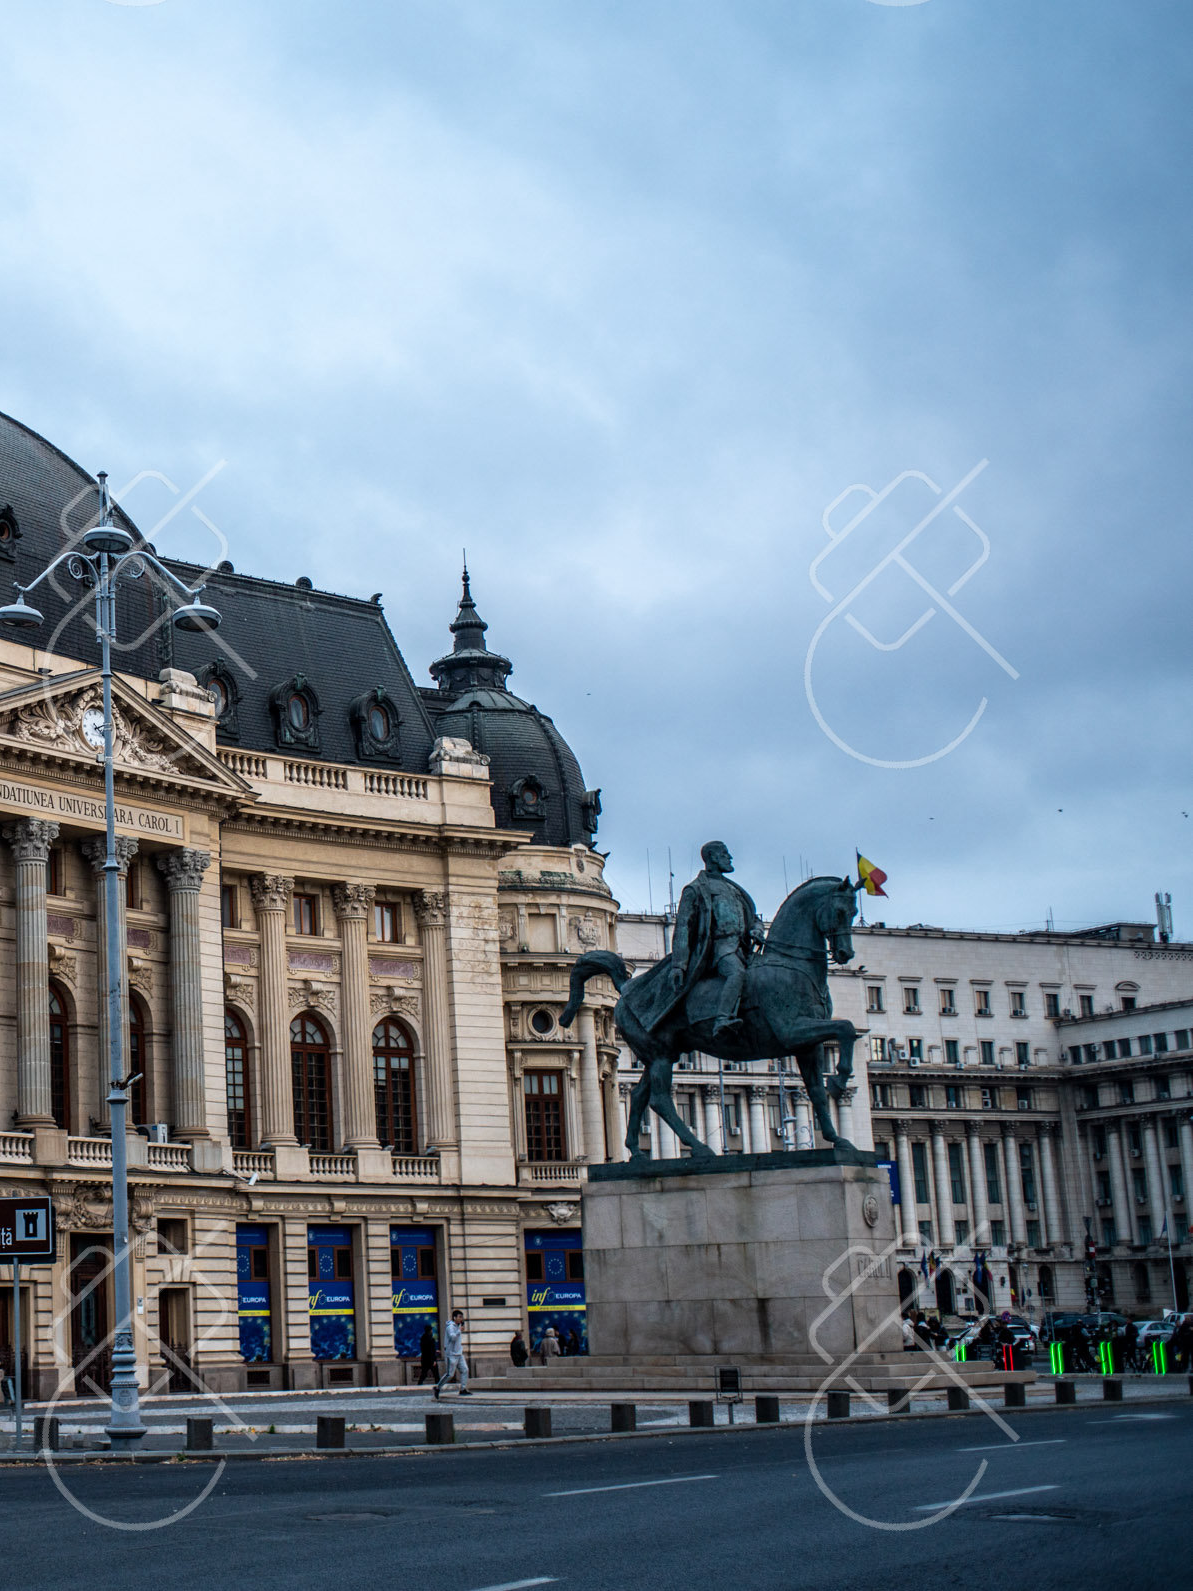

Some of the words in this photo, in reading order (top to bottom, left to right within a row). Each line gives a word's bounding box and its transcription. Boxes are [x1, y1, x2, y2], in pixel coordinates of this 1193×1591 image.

[59, 796, 134, 825] UNIVERSIARA
[138, 813, 172, 832] CAROL
[175, 820, 180, 834] I
